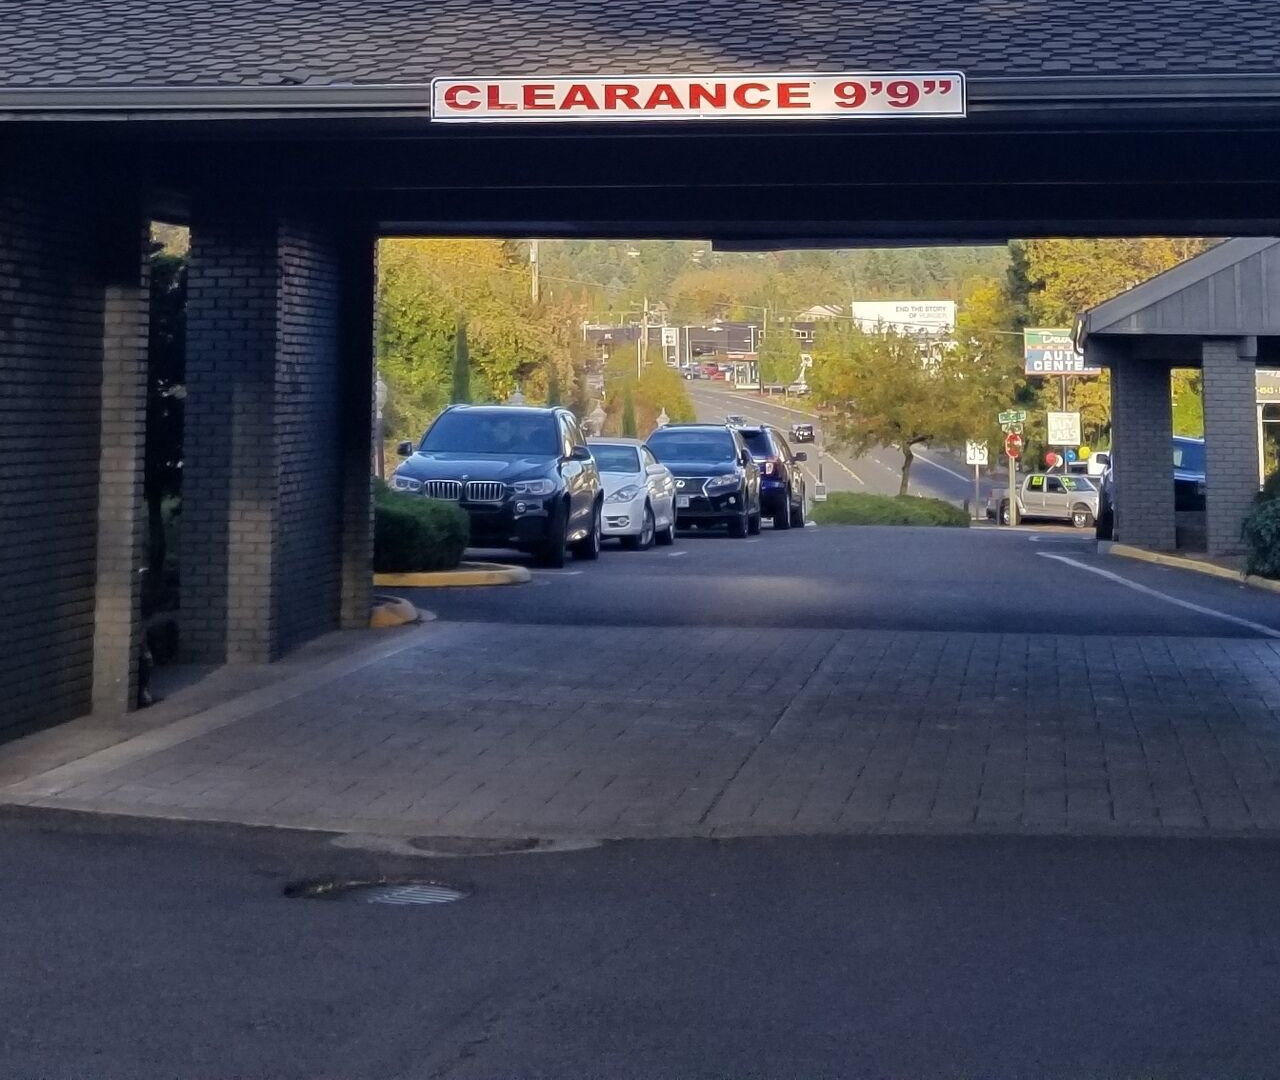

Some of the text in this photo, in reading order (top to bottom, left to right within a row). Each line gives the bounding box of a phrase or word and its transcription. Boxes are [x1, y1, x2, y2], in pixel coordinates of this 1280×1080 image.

[444, 82, 812, 112] CLEARANCE
[925, 305, 947, 313] STORY
[1033, 360, 1093, 371] CENTE
